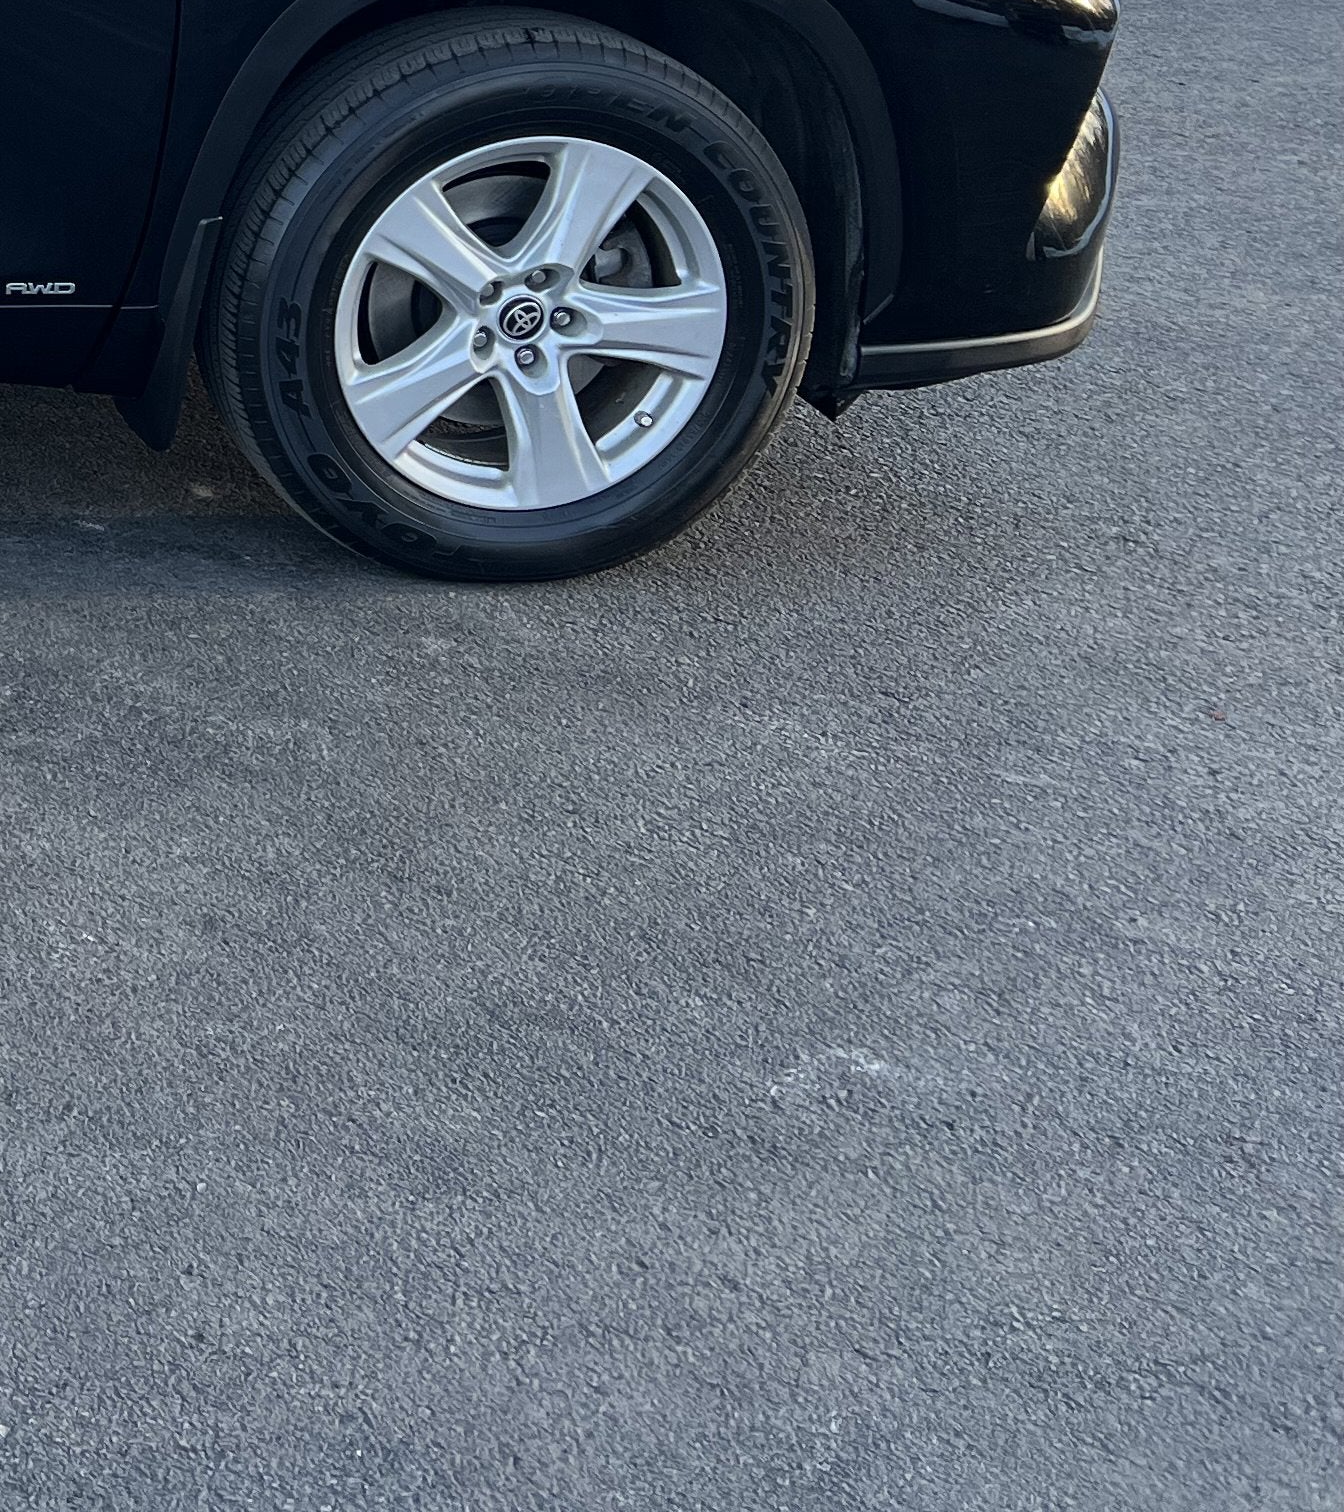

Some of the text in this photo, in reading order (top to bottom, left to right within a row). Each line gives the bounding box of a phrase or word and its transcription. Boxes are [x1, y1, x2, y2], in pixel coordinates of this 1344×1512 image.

[5, 281, 76, 295] AWD
[705, 139, 794, 398] COUNTRY
[273, 296, 312, 419] A43
